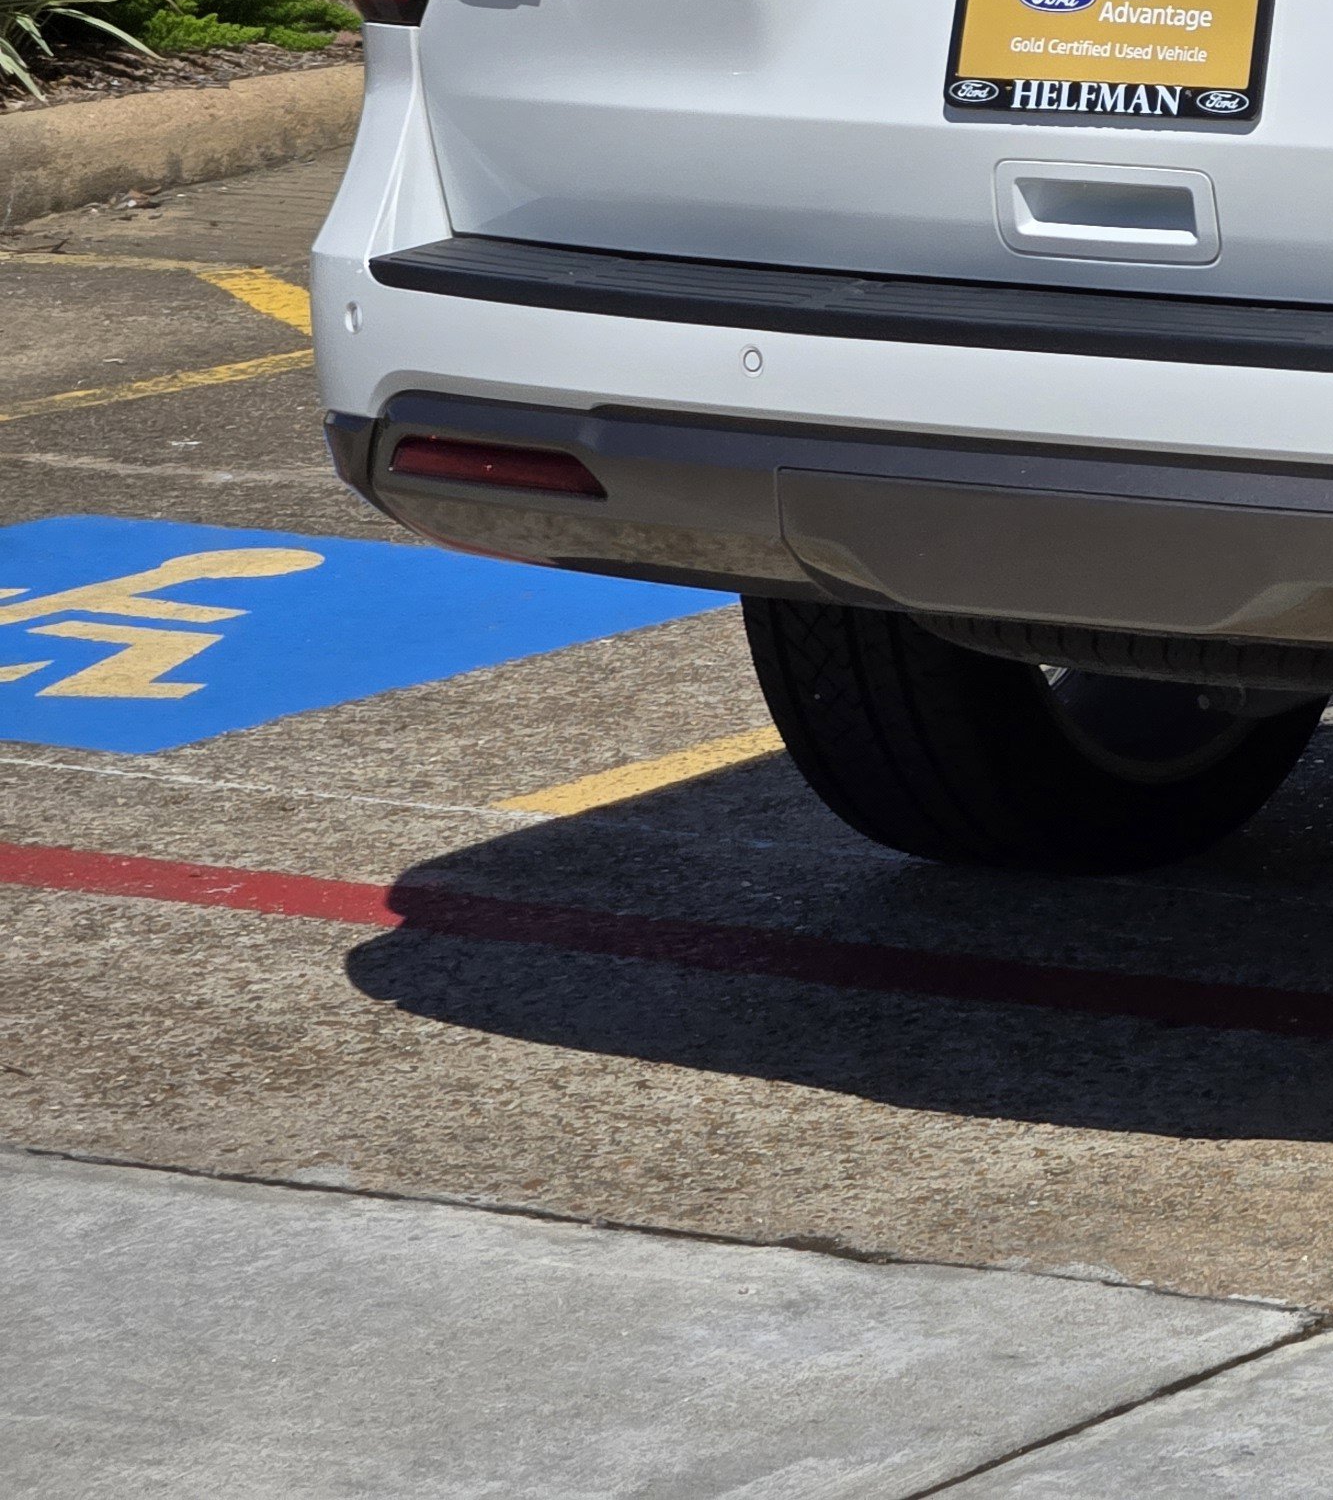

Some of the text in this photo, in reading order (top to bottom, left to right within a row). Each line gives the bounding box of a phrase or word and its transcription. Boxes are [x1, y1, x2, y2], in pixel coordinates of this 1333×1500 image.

[1098, 1, 1213, 32] Advantage
[1009, 36, 1208, 63] Gold Certified Used Vehicle
[955, 82, 992, 101] Ford
[1009, 78, 1184, 117] HELFMAN
[1203, 92, 1242, 112] Ford
